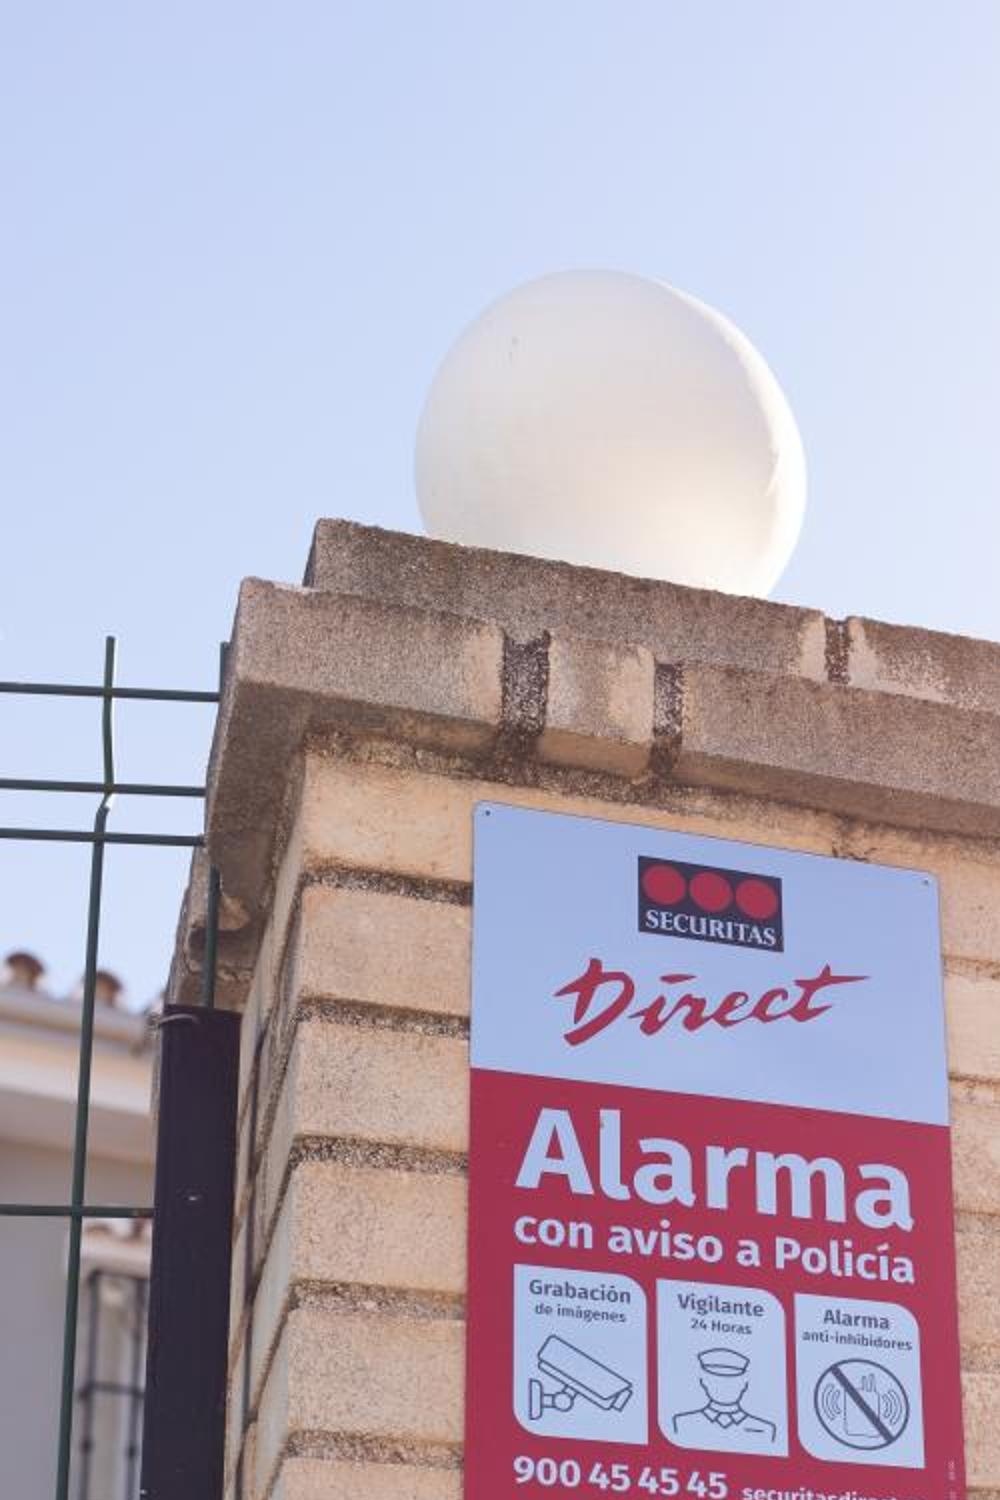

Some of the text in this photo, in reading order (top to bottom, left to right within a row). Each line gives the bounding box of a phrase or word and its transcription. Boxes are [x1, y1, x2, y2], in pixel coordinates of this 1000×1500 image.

[645, 909, 776, 947] SECURITAS
[554, 958, 869, 1046] Direct
[515, 1107, 915, 1231] Alarma
[514, 1216, 915, 1284] con aviso a Policía
[529, 1279, 631, 1305] Grabación
[535, 1303, 626, 1323] de imágenes
[678, 1293, 764, 1318] Vigilante
[690, 1319, 751, 1335] 24 Horas
[823, 1309, 889, 1330] Alarma
[802, 1331, 912, 1351] anti-inhibidores
[513, 1456, 581, 1487] 900
[588, 1463, 630, 1492] 45
[638, 1468, 680, 1496] 45
[687, 1472, 728, 1500] 45
